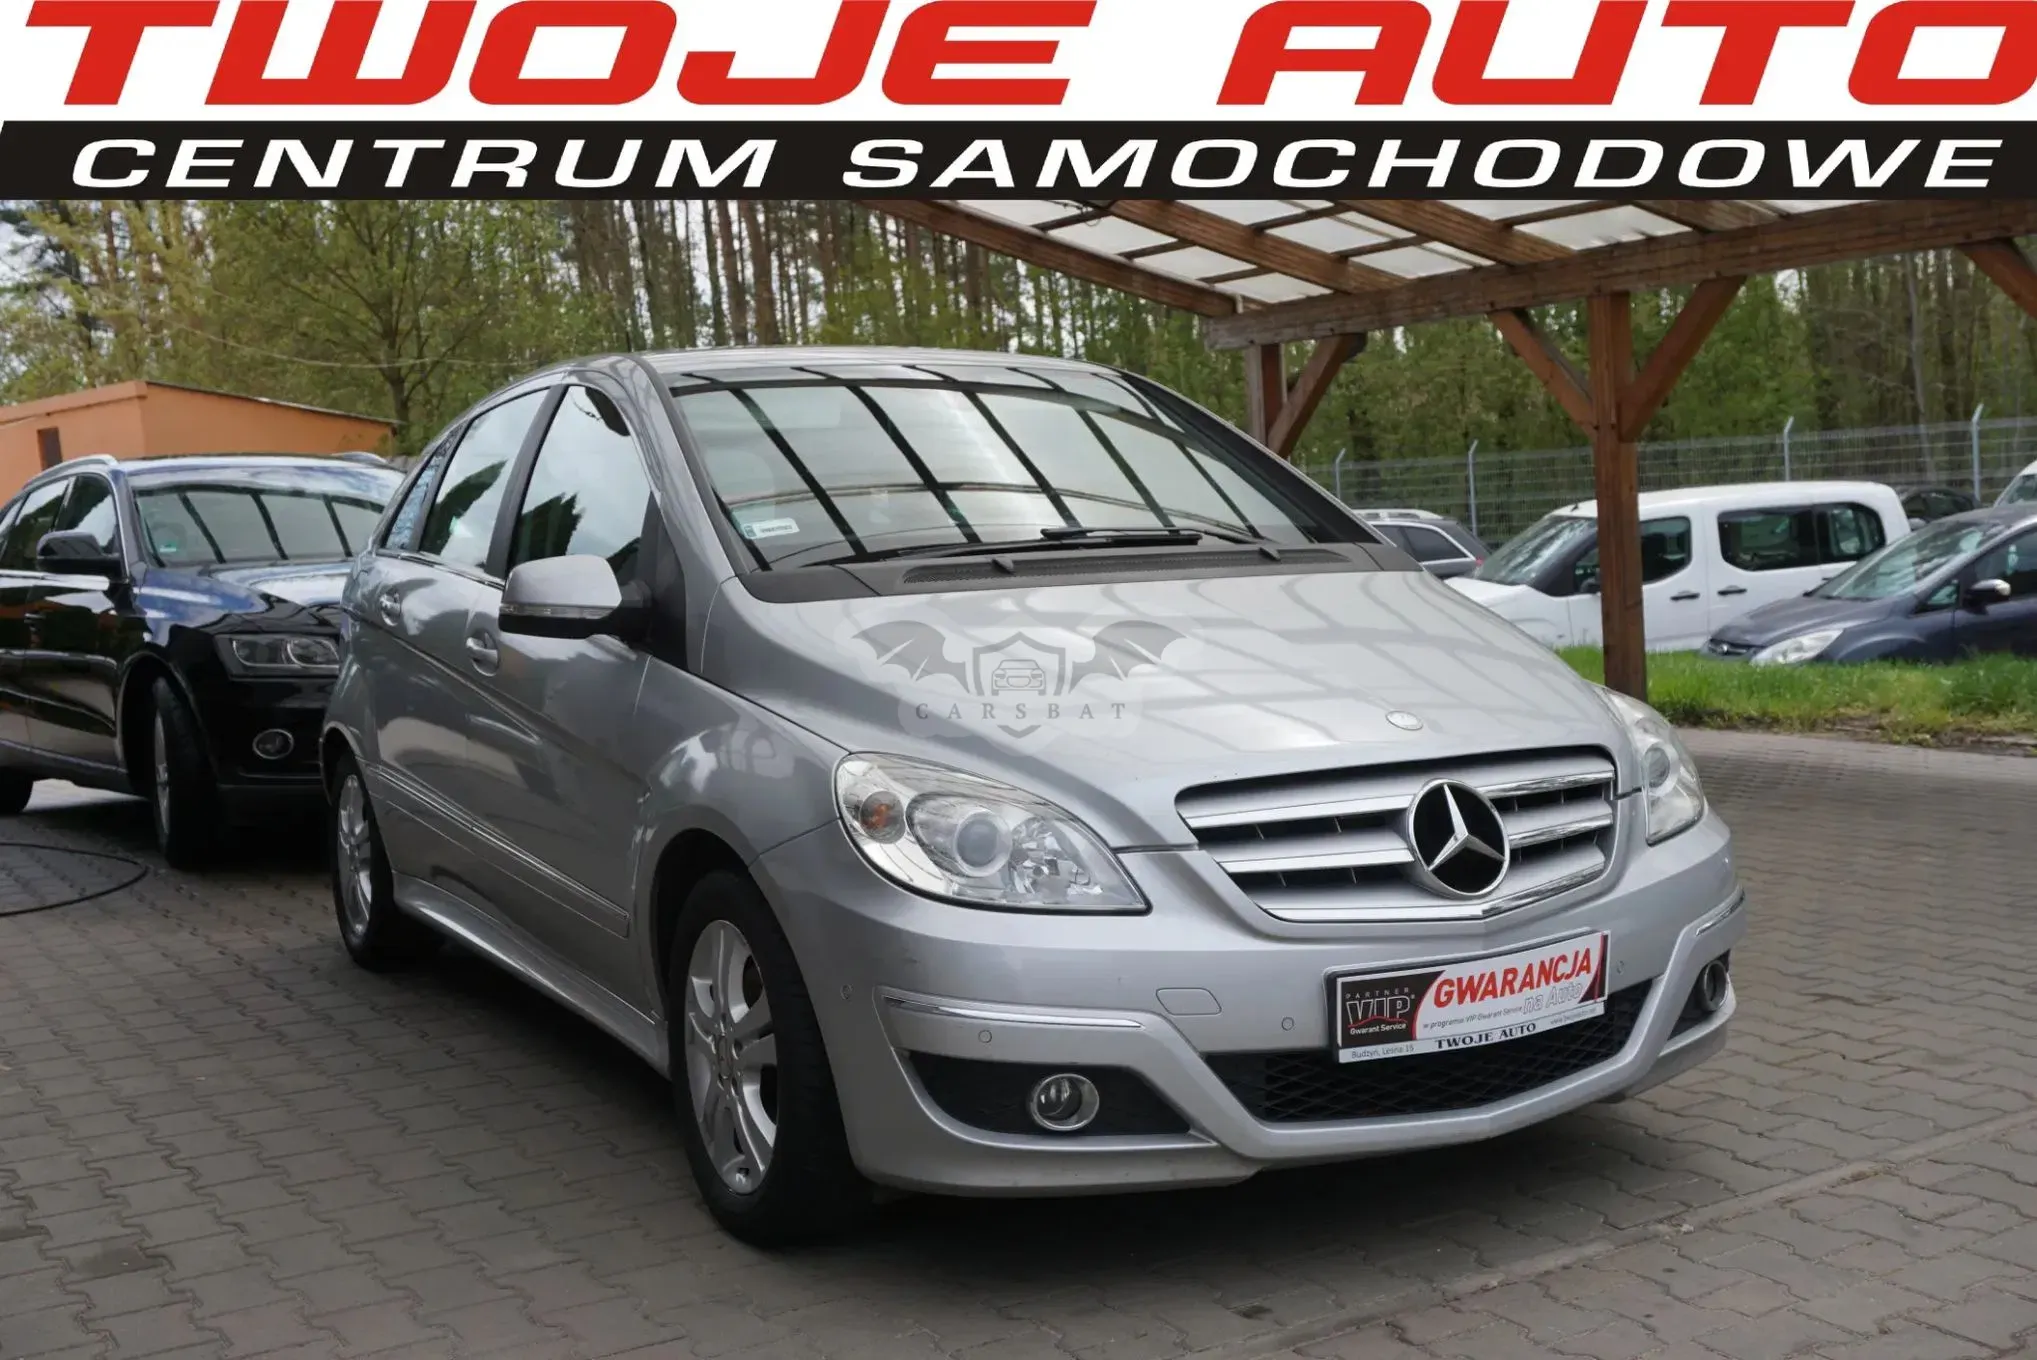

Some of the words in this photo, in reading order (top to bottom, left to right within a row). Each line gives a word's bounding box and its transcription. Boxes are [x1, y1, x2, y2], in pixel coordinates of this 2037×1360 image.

[1433, 947, 1592, 1009] GWARANCJA
[1345, 987, 1409, 999] PARTNER
[1523, 994, 1544, 1015] na
[1546, 981, 1583, 1008] Auto
[1346, 996, 1410, 1025] VIP
[1350, 1025, 1380, 1036] Gwarant
[1380, 1023, 1407, 1032] Service
[1435, 1032, 1493, 1049] TWOJE
[1499, 1022, 1537, 1040] AUTO
